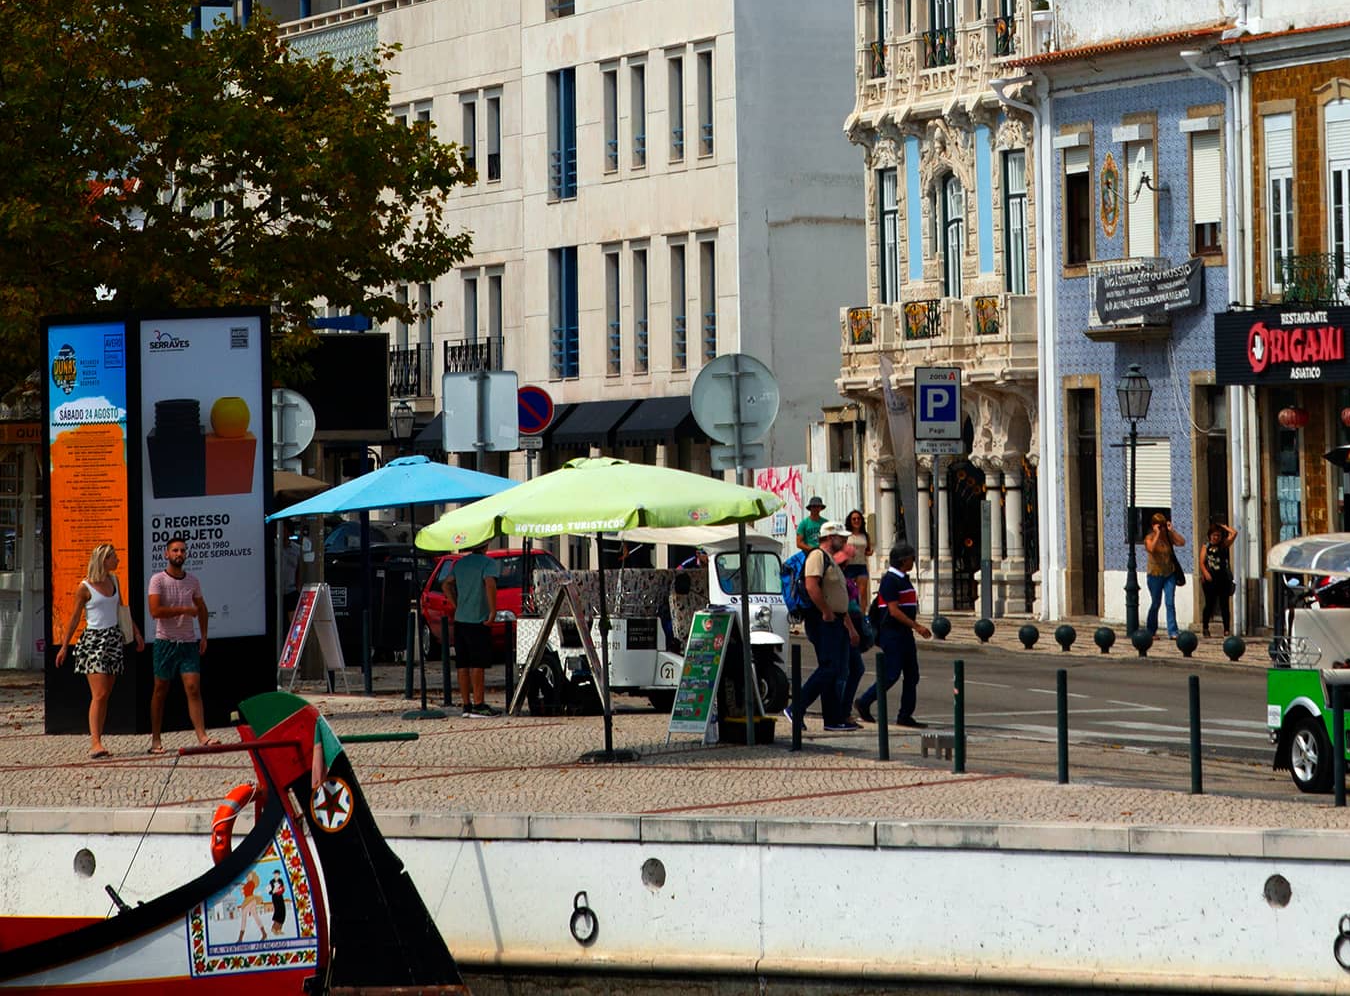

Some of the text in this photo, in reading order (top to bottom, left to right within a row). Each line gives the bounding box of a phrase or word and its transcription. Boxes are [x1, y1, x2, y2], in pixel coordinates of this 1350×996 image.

[1280, 311, 1328, 325] RESTAURANTE
[1248, 322, 1345, 373] ORIGAMI
[948, 371, 956, 381] A
[926, 388, 950, 419] P
[59, 406, 119, 421] SÁBADO 24 AGOSTO
[152, 514, 230, 529] O REGRESSO
[515, 523, 564, 533] ROTEIROS
[152, 528, 224, 543] DO OBJETO
[190, 541, 211, 551] ANOS
[212, 540, 230, 549] 1980
[199, 549, 209, 559] DE
[210, 547, 252, 558] SERRALVES
[754, 595, 768, 604] 342
[664, 667, 675, 679] 21
